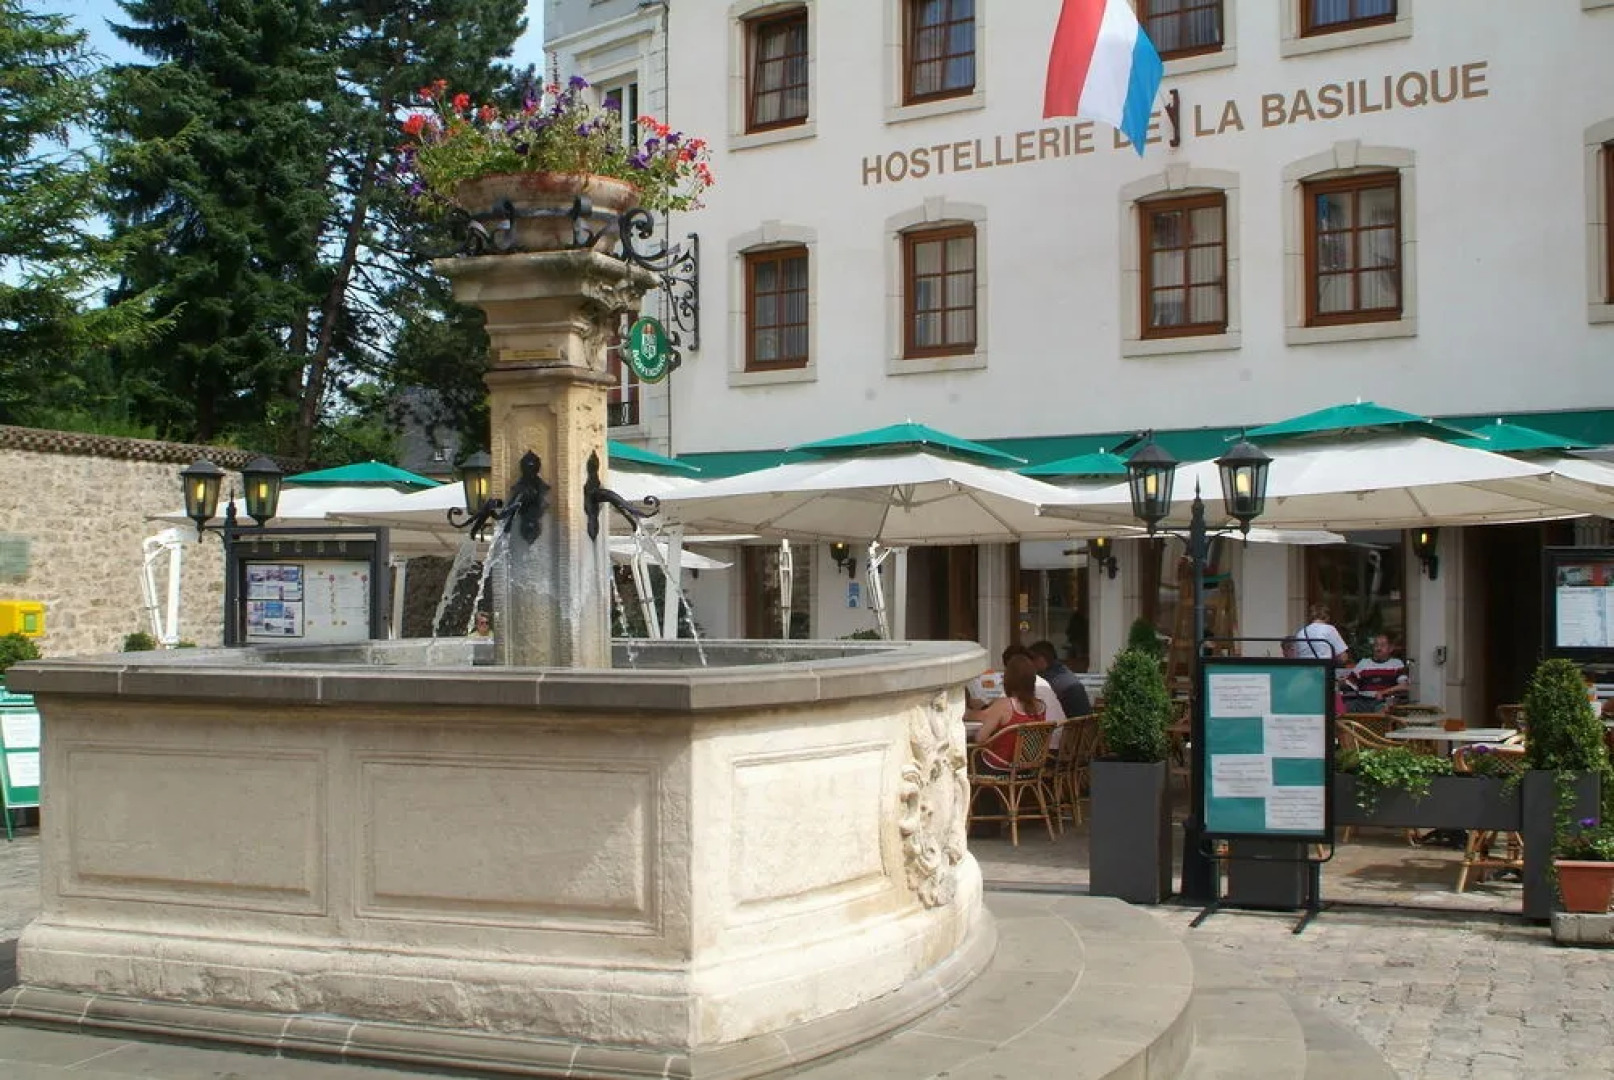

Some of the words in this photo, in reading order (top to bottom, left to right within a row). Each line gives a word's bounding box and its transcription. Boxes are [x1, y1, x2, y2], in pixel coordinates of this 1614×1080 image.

[862, 120, 1095, 185] HOSTELLERIE
[1194, 102, 1243, 137] LA
[1261, 61, 1489, 128] BASILIQUE
